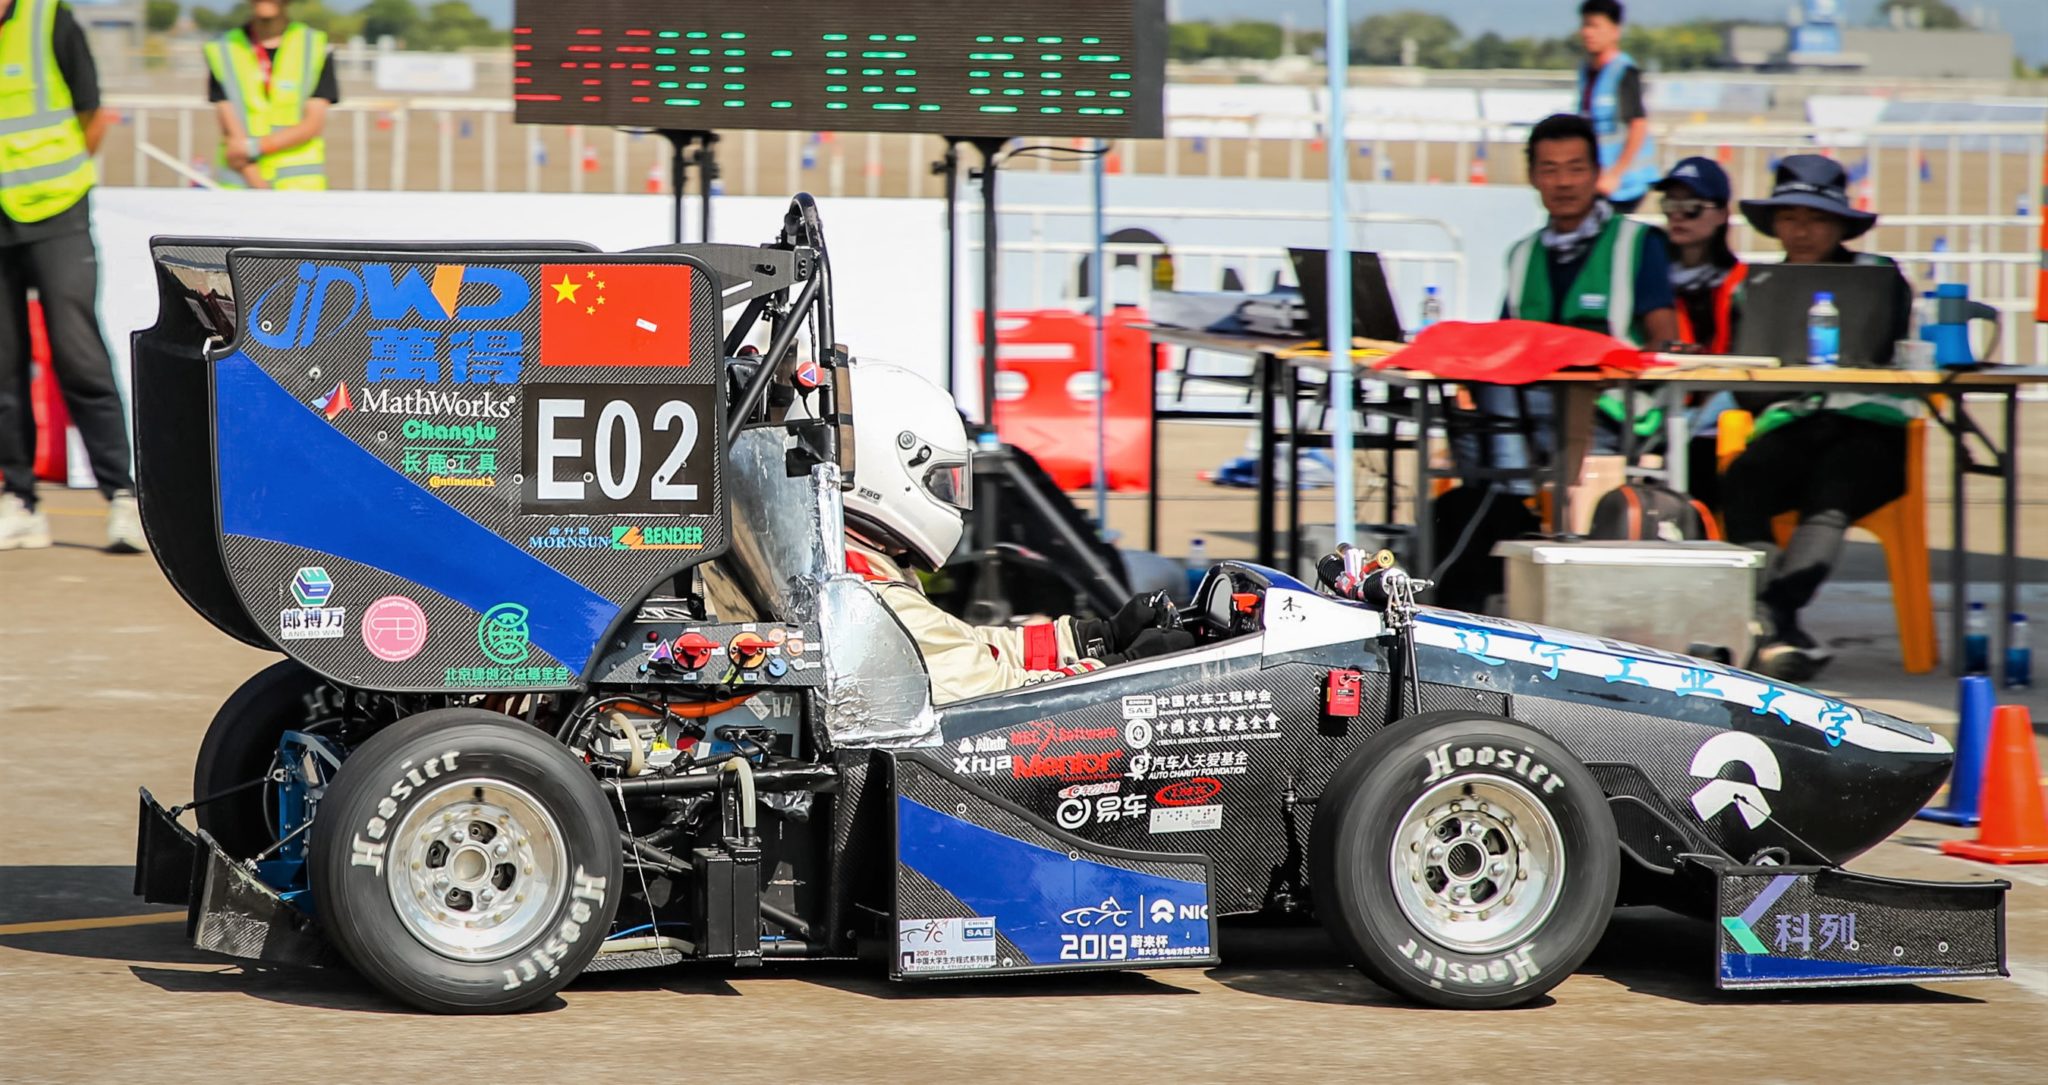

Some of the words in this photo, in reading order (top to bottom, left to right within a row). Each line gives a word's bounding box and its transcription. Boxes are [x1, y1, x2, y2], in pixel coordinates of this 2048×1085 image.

[537, 399, 699, 501] E02
[402, 452, 497, 475] 长鹿工具
[530, 536, 609, 549] MORNSUN
[643, 526, 703, 545] BENDER
[283, 610, 343, 629] 郎搏万
[323, 629, 342, 637] WAN
[1157, 689, 1272, 708] 中国汽车工程学会
[1455, 625, 1853, 748] 辽宁工业大学
[1012, 750, 1114, 779] Mentor
[1148, 771, 1168, 779] AUTO
[1169, 768, 1200, 778] CHARITY
[1201, 767, 1246, 776] FOUNDATION
[1151, 751, 1248, 771] 汽车人关爱基金
[1423, 743, 1565, 795] Hoosier
[350, 751, 461, 877] Hoosier
[1096, 793, 1147, 823] 易车
[502, 864, 607, 991] Hoosier
[966, 928, 991, 936] SAE
[1775, 913, 1857, 951] 科列
[1060, 934, 1127, 960] 2019
[1131, 935, 1168, 948] 蔚来杯
[1398, 938, 1543, 989] Hoosier
